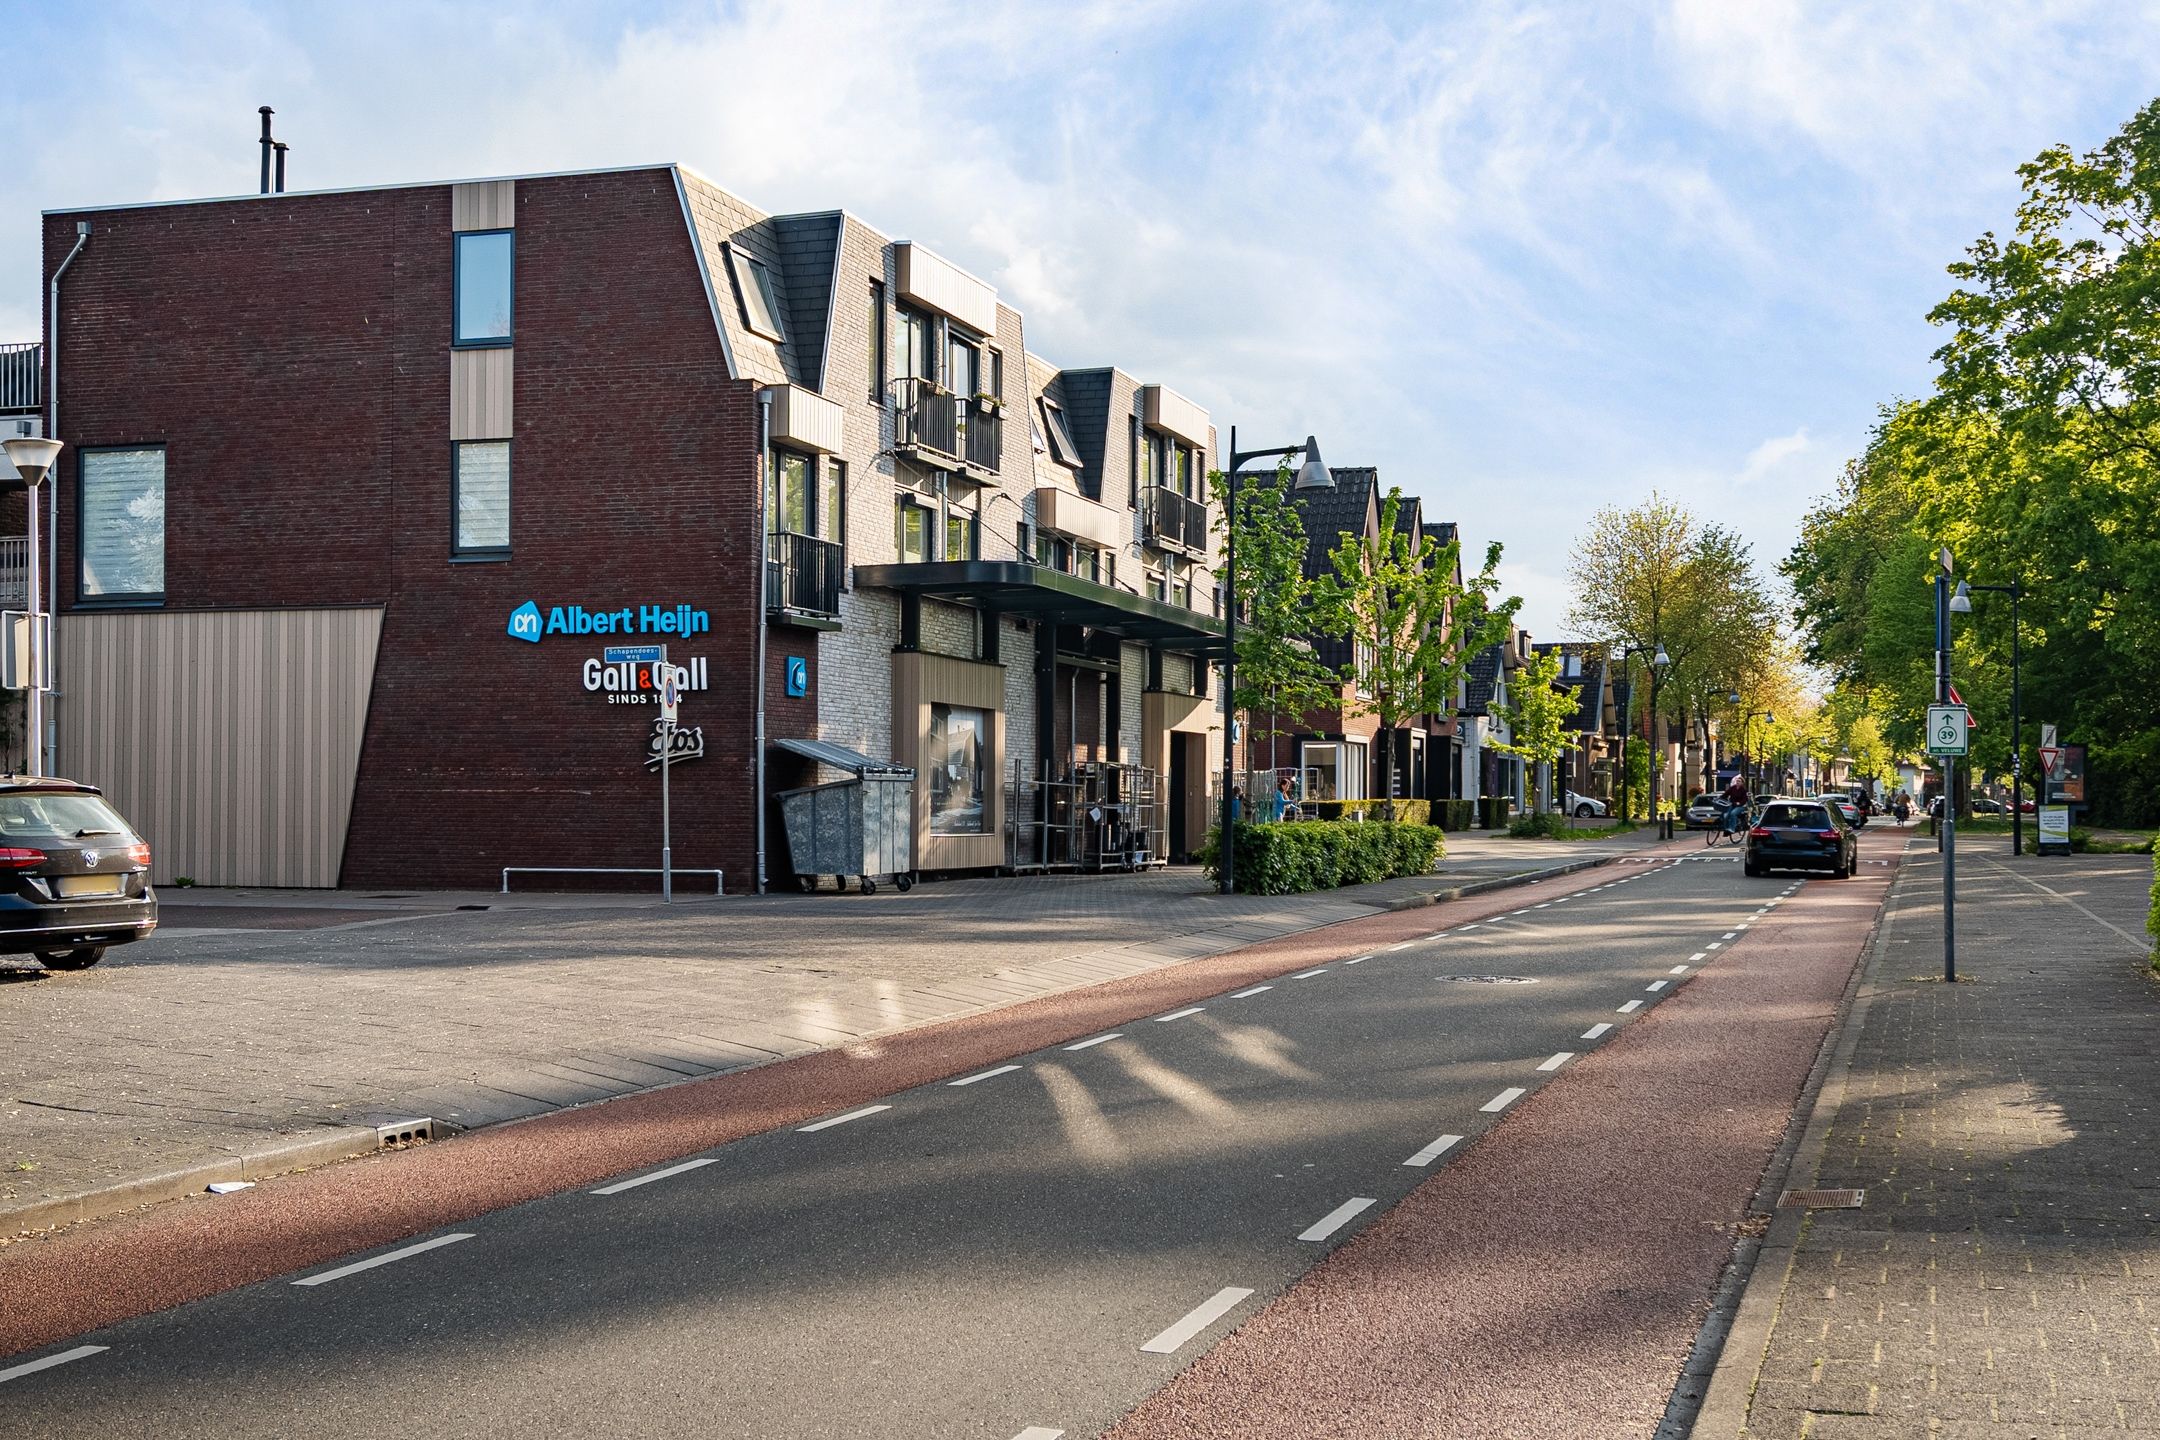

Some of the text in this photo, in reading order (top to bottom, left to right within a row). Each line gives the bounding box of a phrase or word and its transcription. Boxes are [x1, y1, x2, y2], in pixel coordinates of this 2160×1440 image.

[546, 604, 709, 639] Albert Heijn
[607, 694, 647, 704] SINDS
[1940, 730, 1954, 740] 39
